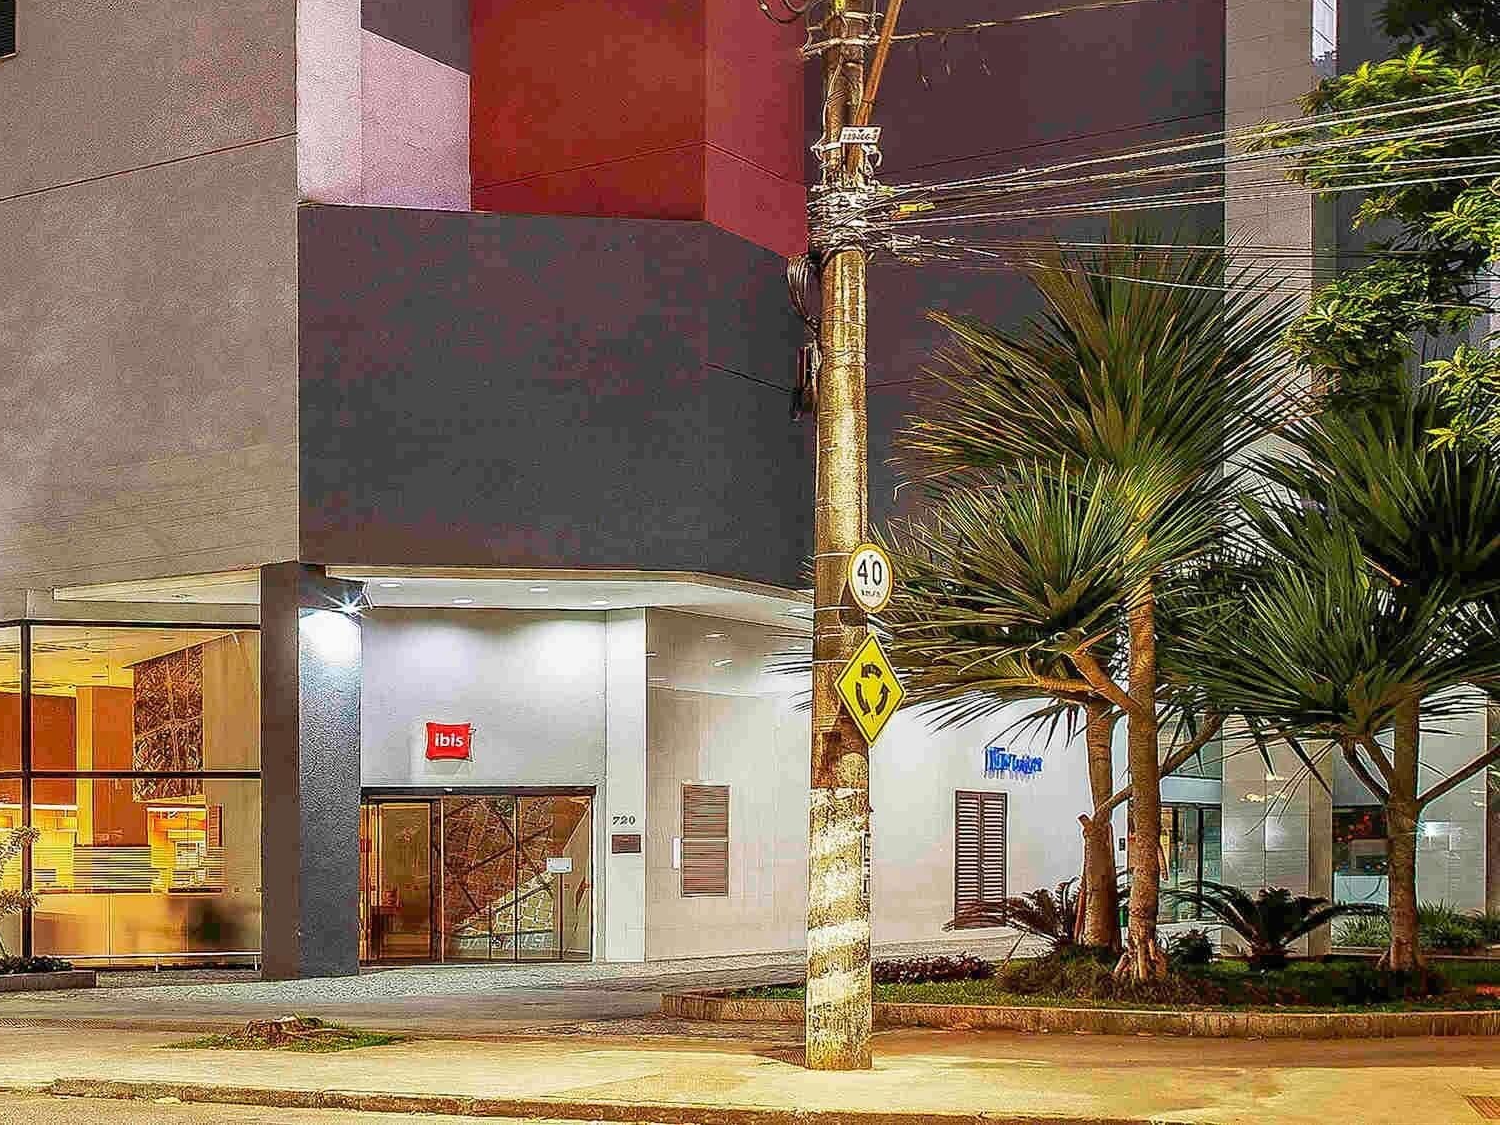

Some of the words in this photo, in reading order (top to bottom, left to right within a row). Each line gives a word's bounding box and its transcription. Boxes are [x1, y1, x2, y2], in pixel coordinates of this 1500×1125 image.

[857, 559, 882, 586] 40
[435, 732, 464, 747] ibis
[612, 815, 636, 825] 720
